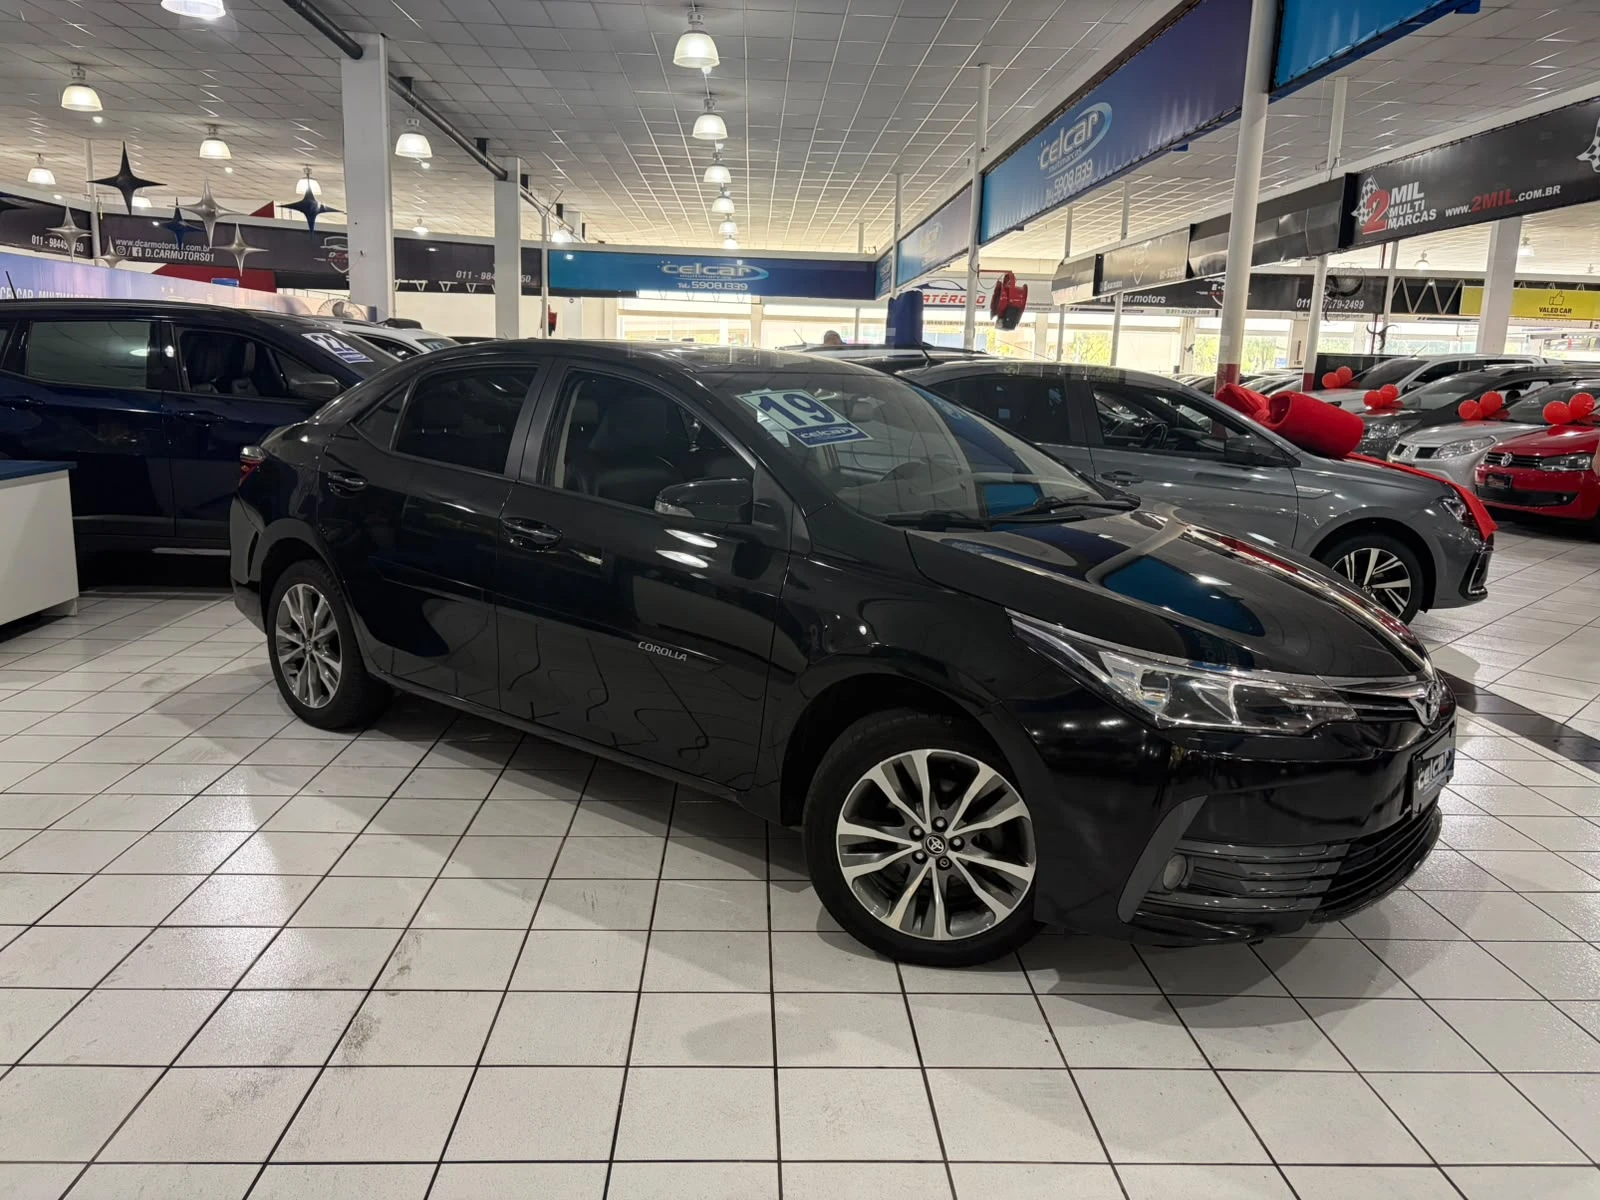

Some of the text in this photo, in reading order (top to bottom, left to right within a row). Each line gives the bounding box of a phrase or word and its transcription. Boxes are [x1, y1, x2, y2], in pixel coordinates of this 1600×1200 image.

[1040, 111, 1098, 170] celcar
[1390, 181, 1424, 206] MIL
[1361, 189, 1391, 235] 2
[1388, 199, 1426, 218] MULTI
[1387, 208, 1437, 230] MARCAS
[31, 234, 43, 246] 011
[145, 247, 215, 262] D.CARMOTORS01
[455, 270, 472, 280] 011
[661, 262, 752, 277] celcar
[1296, 297, 1311, 308] 011
[758, 394, 835, 425] 19
[638, 641, 687, 661] COROLLA
